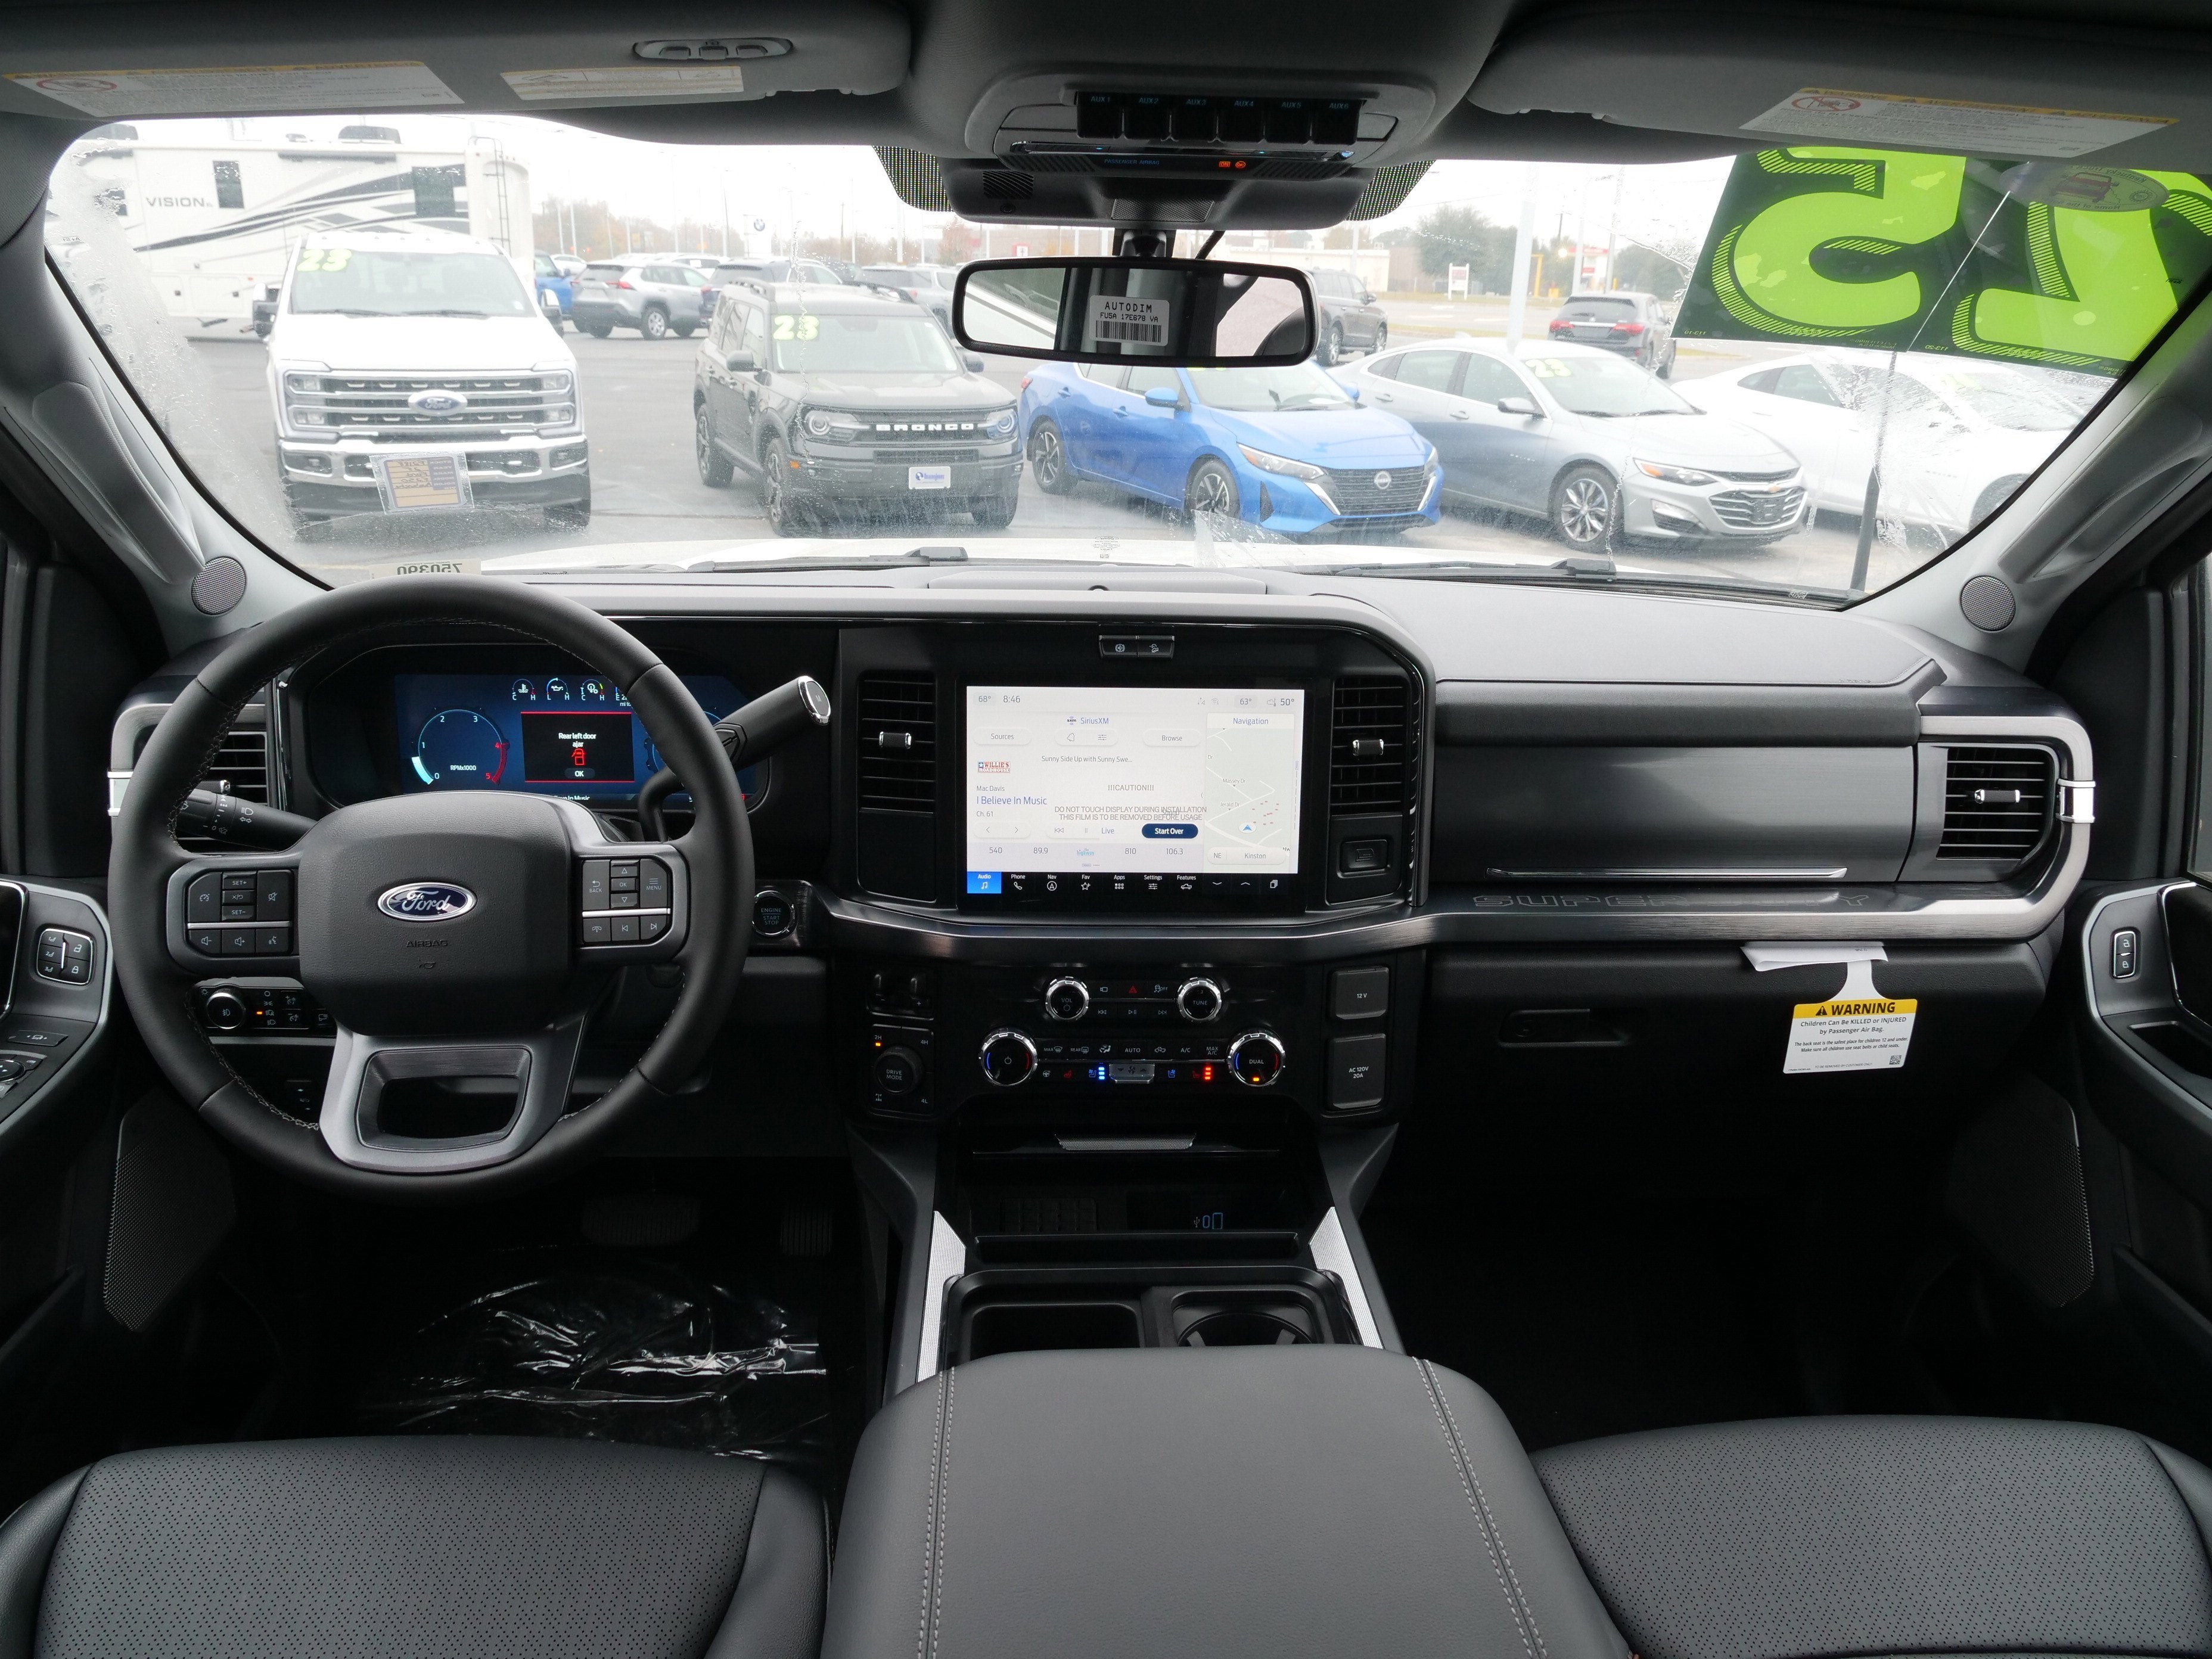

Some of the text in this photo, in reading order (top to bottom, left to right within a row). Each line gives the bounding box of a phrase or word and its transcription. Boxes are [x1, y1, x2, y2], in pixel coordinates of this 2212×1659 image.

[145, 197, 205, 207] VISION
[297, 248, 352, 271] 23
[1105, 302, 1152, 313] AUTODIM
[1525, 358, 1572, 378] 23
[1003, 695, 1021, 703] 8:46
[981, 796, 1012, 804] Believe
[1014, 796, 1021, 804] In
[1023, 796, 1047, 805] Music
[402, 890, 451, 911] Ford
[1473, 894, 1690, 908] SUPER
[1831, 1002, 1896, 1015] WARNING
